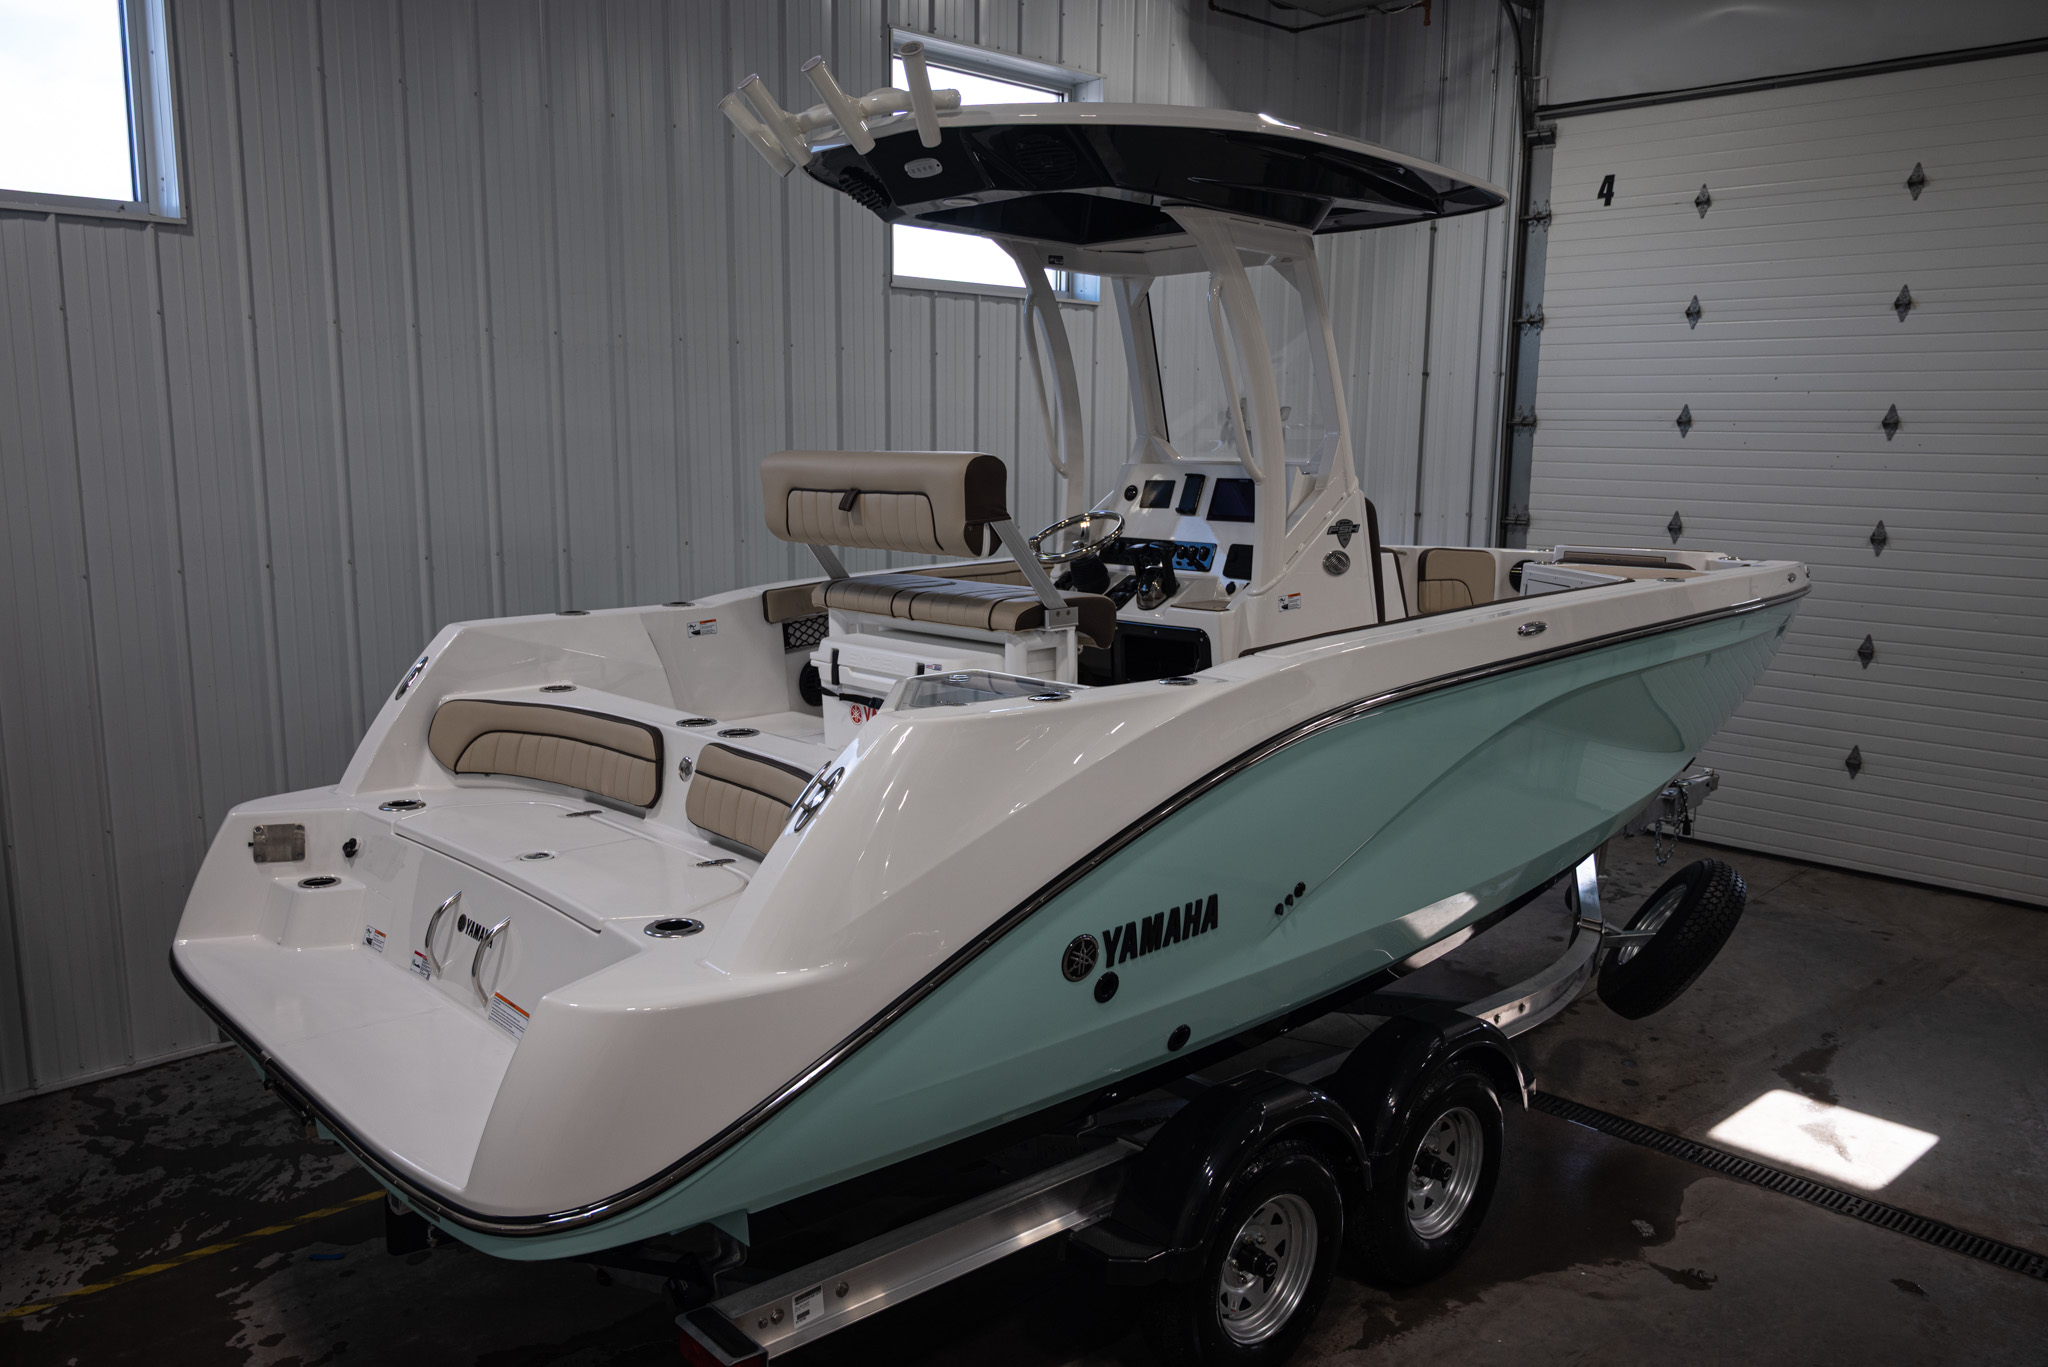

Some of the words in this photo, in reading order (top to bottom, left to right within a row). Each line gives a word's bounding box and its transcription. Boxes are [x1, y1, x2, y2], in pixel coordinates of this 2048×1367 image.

[1597, 174, 1615, 207] 4
[1328, 524, 1360, 535] FSH
[1103, 893, 1218, 968] YAMAHA
